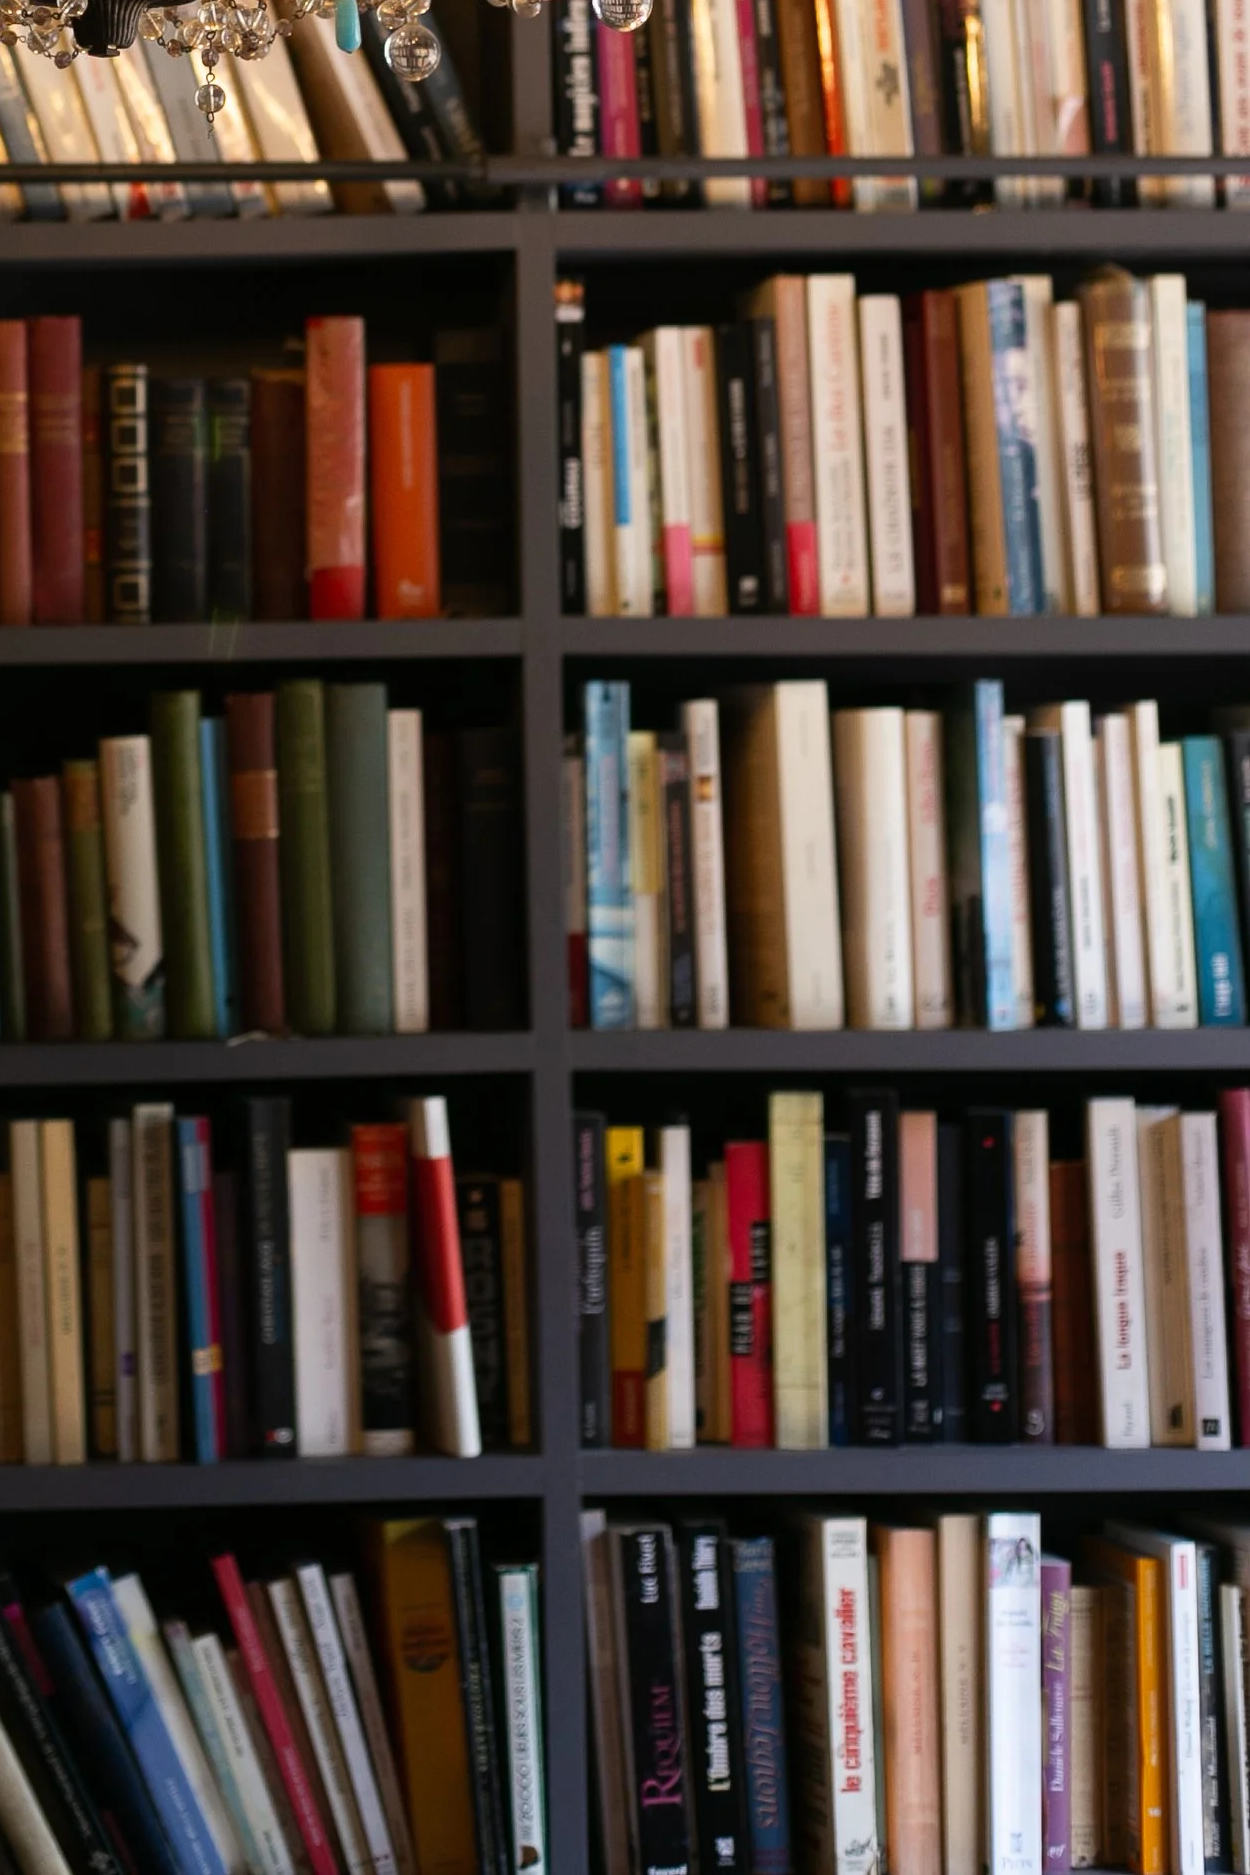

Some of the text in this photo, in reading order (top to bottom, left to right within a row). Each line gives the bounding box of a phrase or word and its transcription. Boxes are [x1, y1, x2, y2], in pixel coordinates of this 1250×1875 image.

[1112, 1301, 1135, 1349] longue
[1113, 1354, 1132, 1371] La
[640, 1576, 660, 1604] Luc
[833, 1586, 857, 1665] cavalier
[700, 1631, 724, 1687] morts
[703, 1688, 726, 1720] des
[837, 1671, 863, 1770] cinquième
[706, 1721, 732, 1792] L'Ombre
[841, 1775, 863, 1794] le
